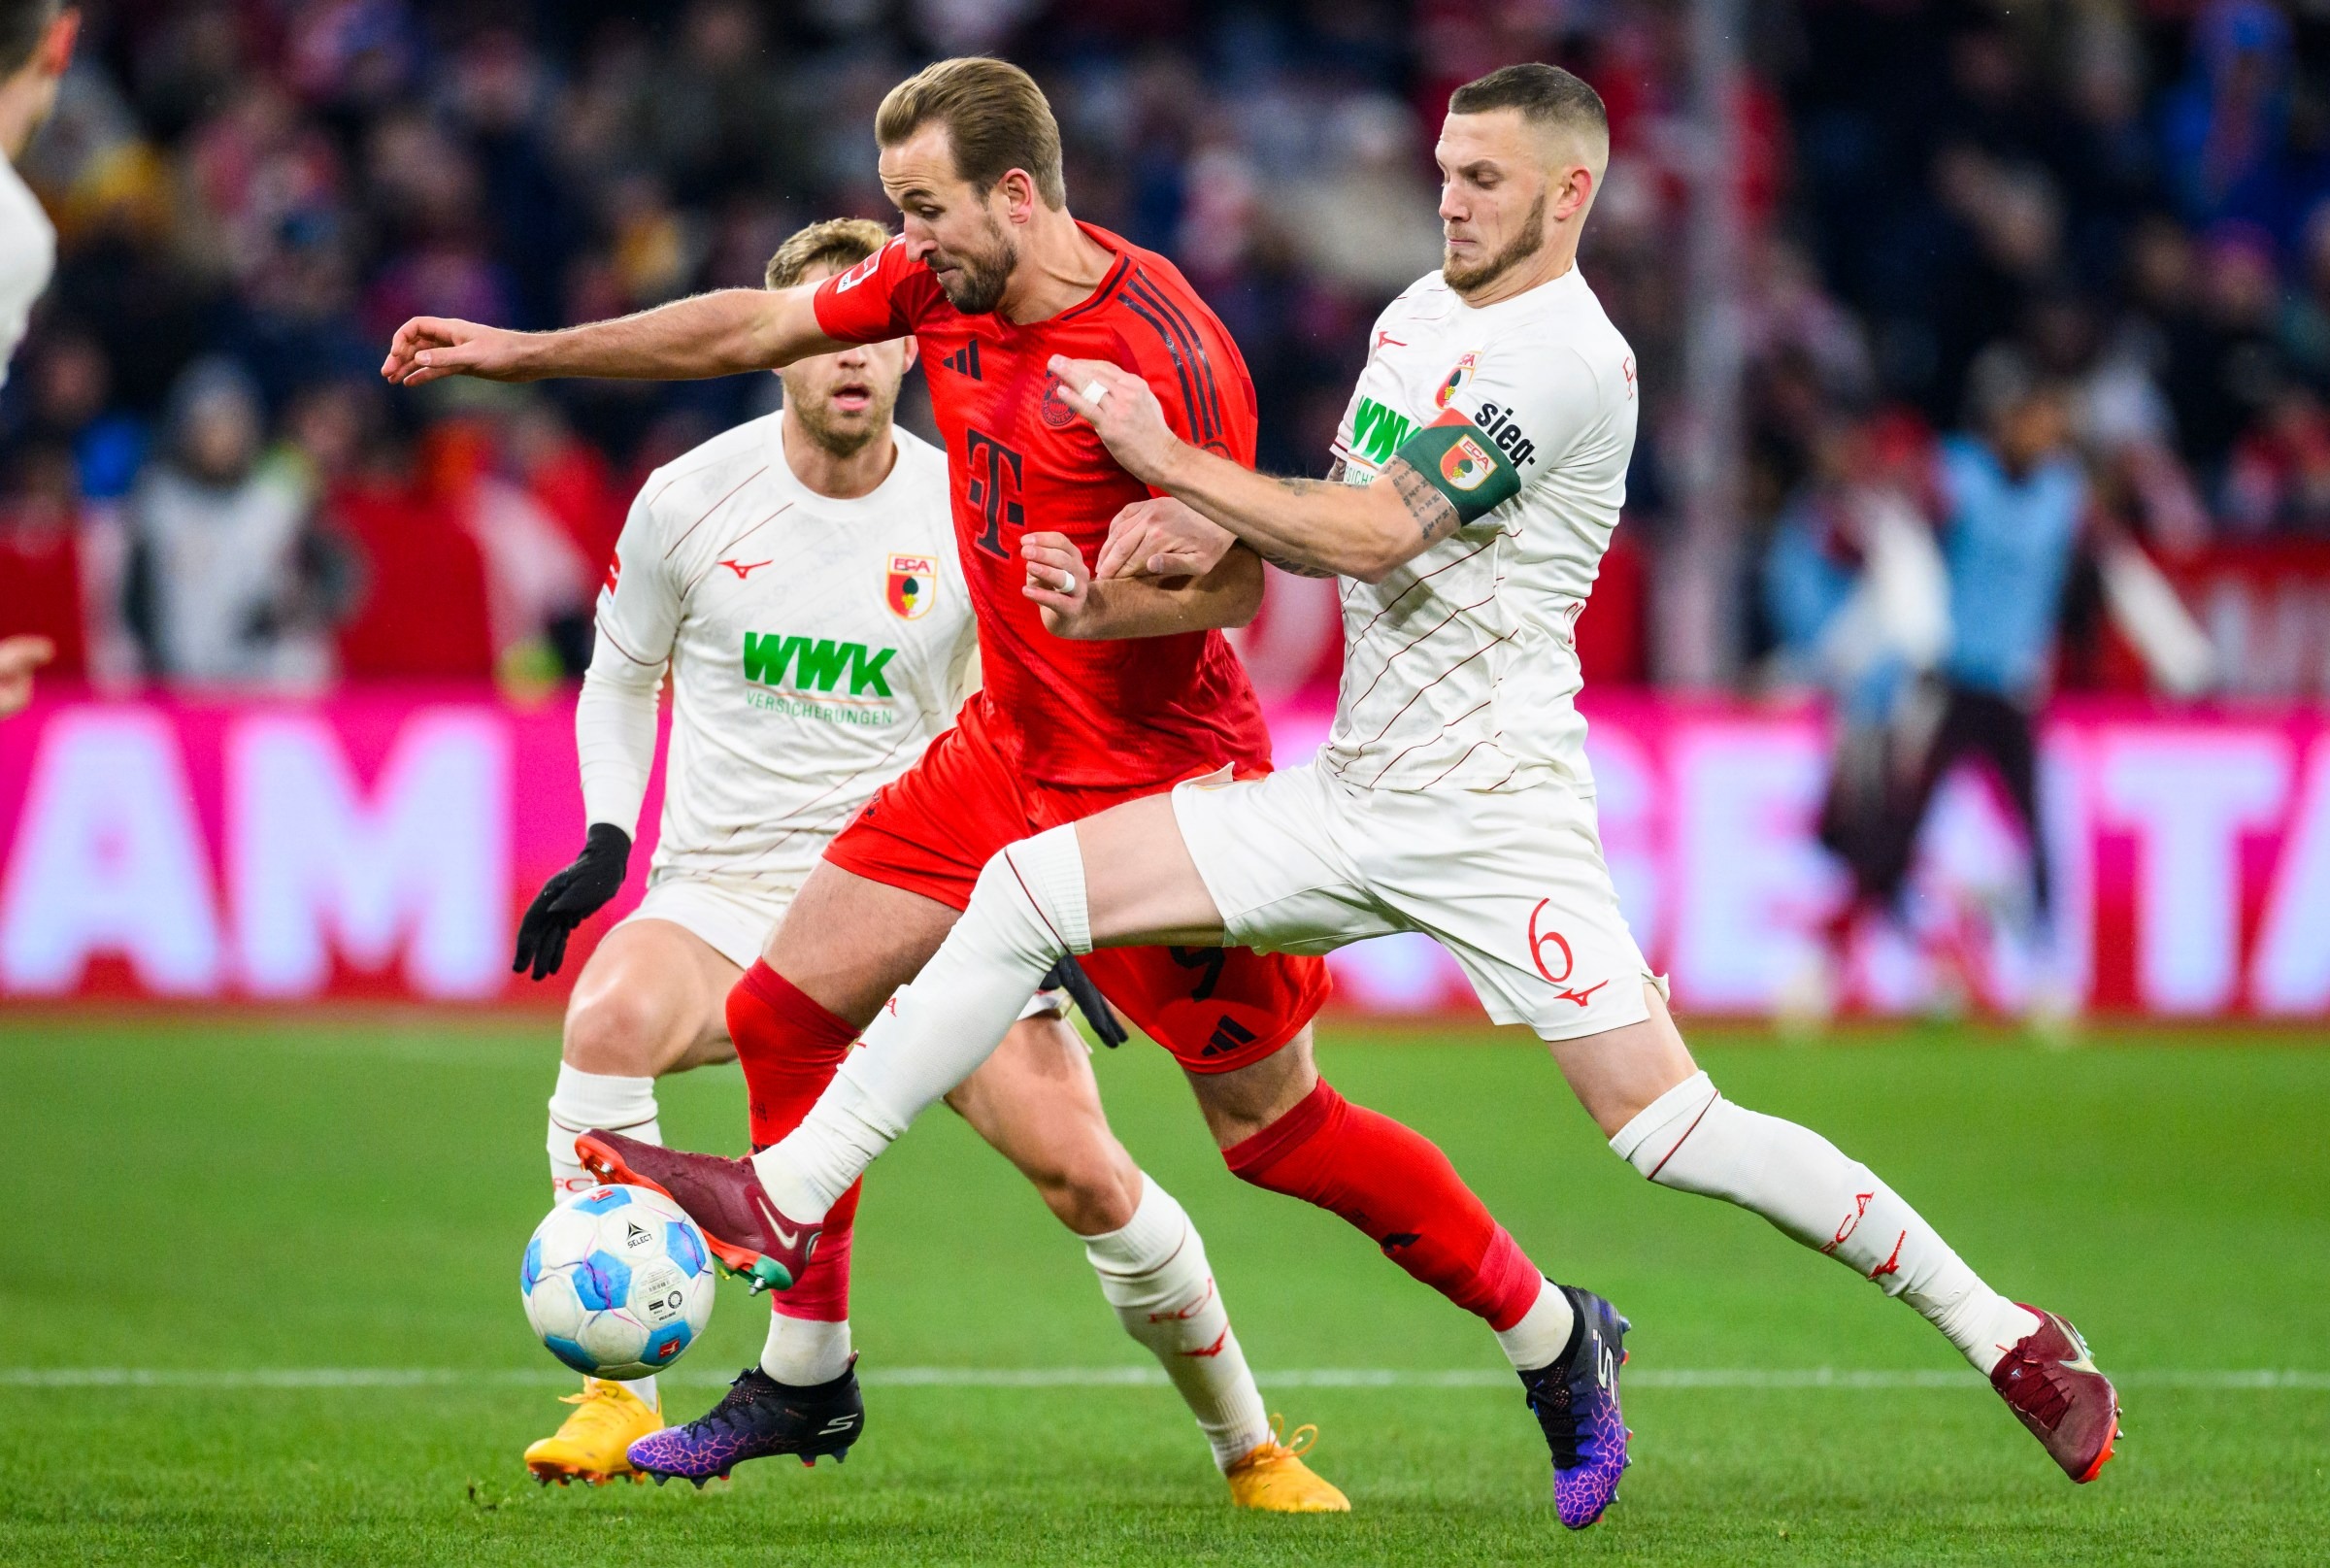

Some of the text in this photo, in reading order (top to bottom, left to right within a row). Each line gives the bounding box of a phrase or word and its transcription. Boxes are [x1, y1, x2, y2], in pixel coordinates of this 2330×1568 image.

[743, 631, 897, 698] WWK
[746, 688, 893, 727] VERSICHERUNGEN
[1528, 896, 1574, 983] 6
[627, 1233, 652, 1249] SELECT
